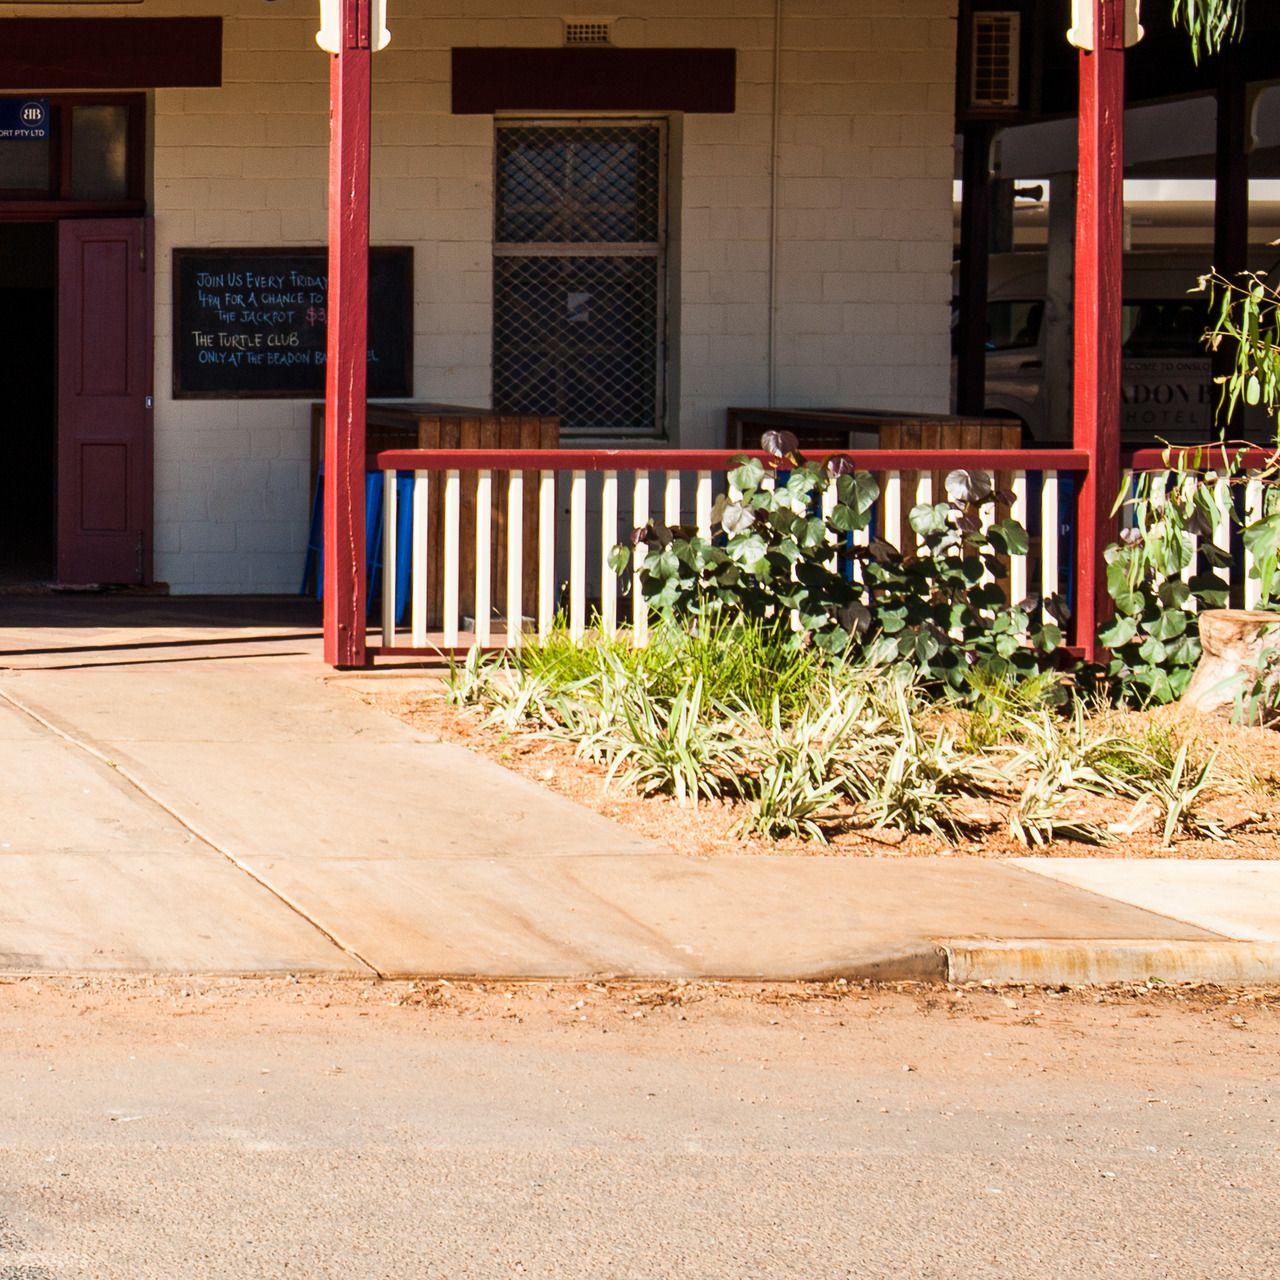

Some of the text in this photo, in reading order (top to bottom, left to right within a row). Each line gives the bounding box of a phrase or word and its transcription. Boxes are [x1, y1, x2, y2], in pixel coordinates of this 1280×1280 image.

[196, 272, 224, 288] JOIN
[227, 272, 243, 287] US
[246, 272, 285, 289] EVERY
[225, 292, 247, 307] FOR
[247, 291, 258, 307] A
[261, 292, 304, 307] CHANCE
[309, 293, 323, 305] TO
[215, 310, 236, 324] THE
[240, 310, 295, 326] JACKPOT
[192, 330, 300, 351] THE TURTLE CLUB
[198, 350, 226, 364] ONLY
[228, 351, 246, 367] AT
[246, 350, 265, 365] THE
[267, 350, 310, 366] BEADON
[1126, 410, 1198, 423] HOTEL
